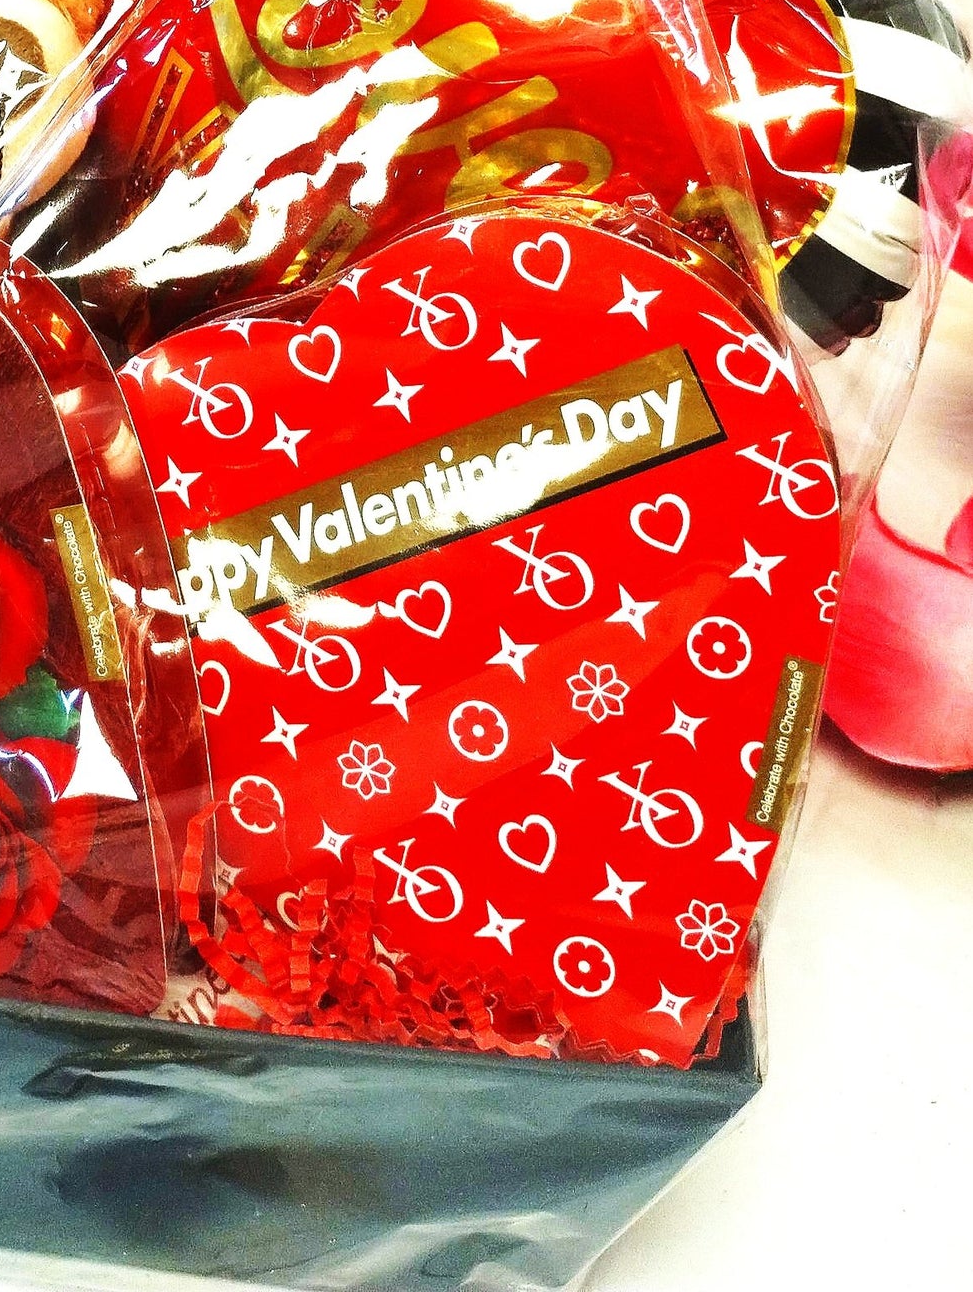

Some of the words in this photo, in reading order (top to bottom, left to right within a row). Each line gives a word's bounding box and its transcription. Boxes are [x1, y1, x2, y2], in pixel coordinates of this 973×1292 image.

[559, 380, 683, 449] Day
[80, 586, 95, 613] with
[87, 615, 108, 677] Celebrate
[756, 763, 783, 823] Celebrate
[775, 736, 790, 763] with
